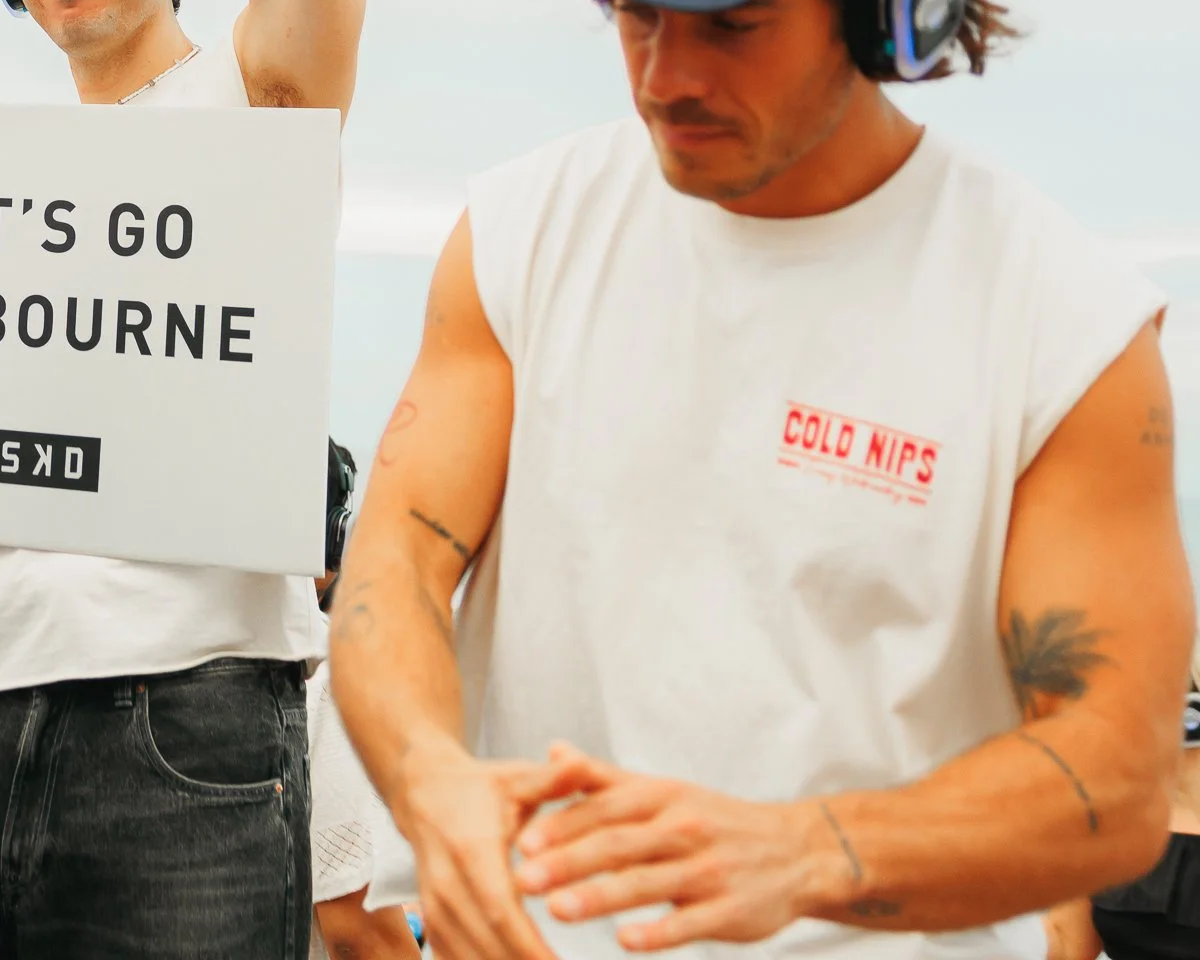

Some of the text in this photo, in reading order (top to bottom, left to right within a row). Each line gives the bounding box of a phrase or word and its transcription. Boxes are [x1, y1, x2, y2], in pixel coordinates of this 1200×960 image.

[108, 202, 194, 259] GO
[783, 410, 937, 483] COLD NIPS
